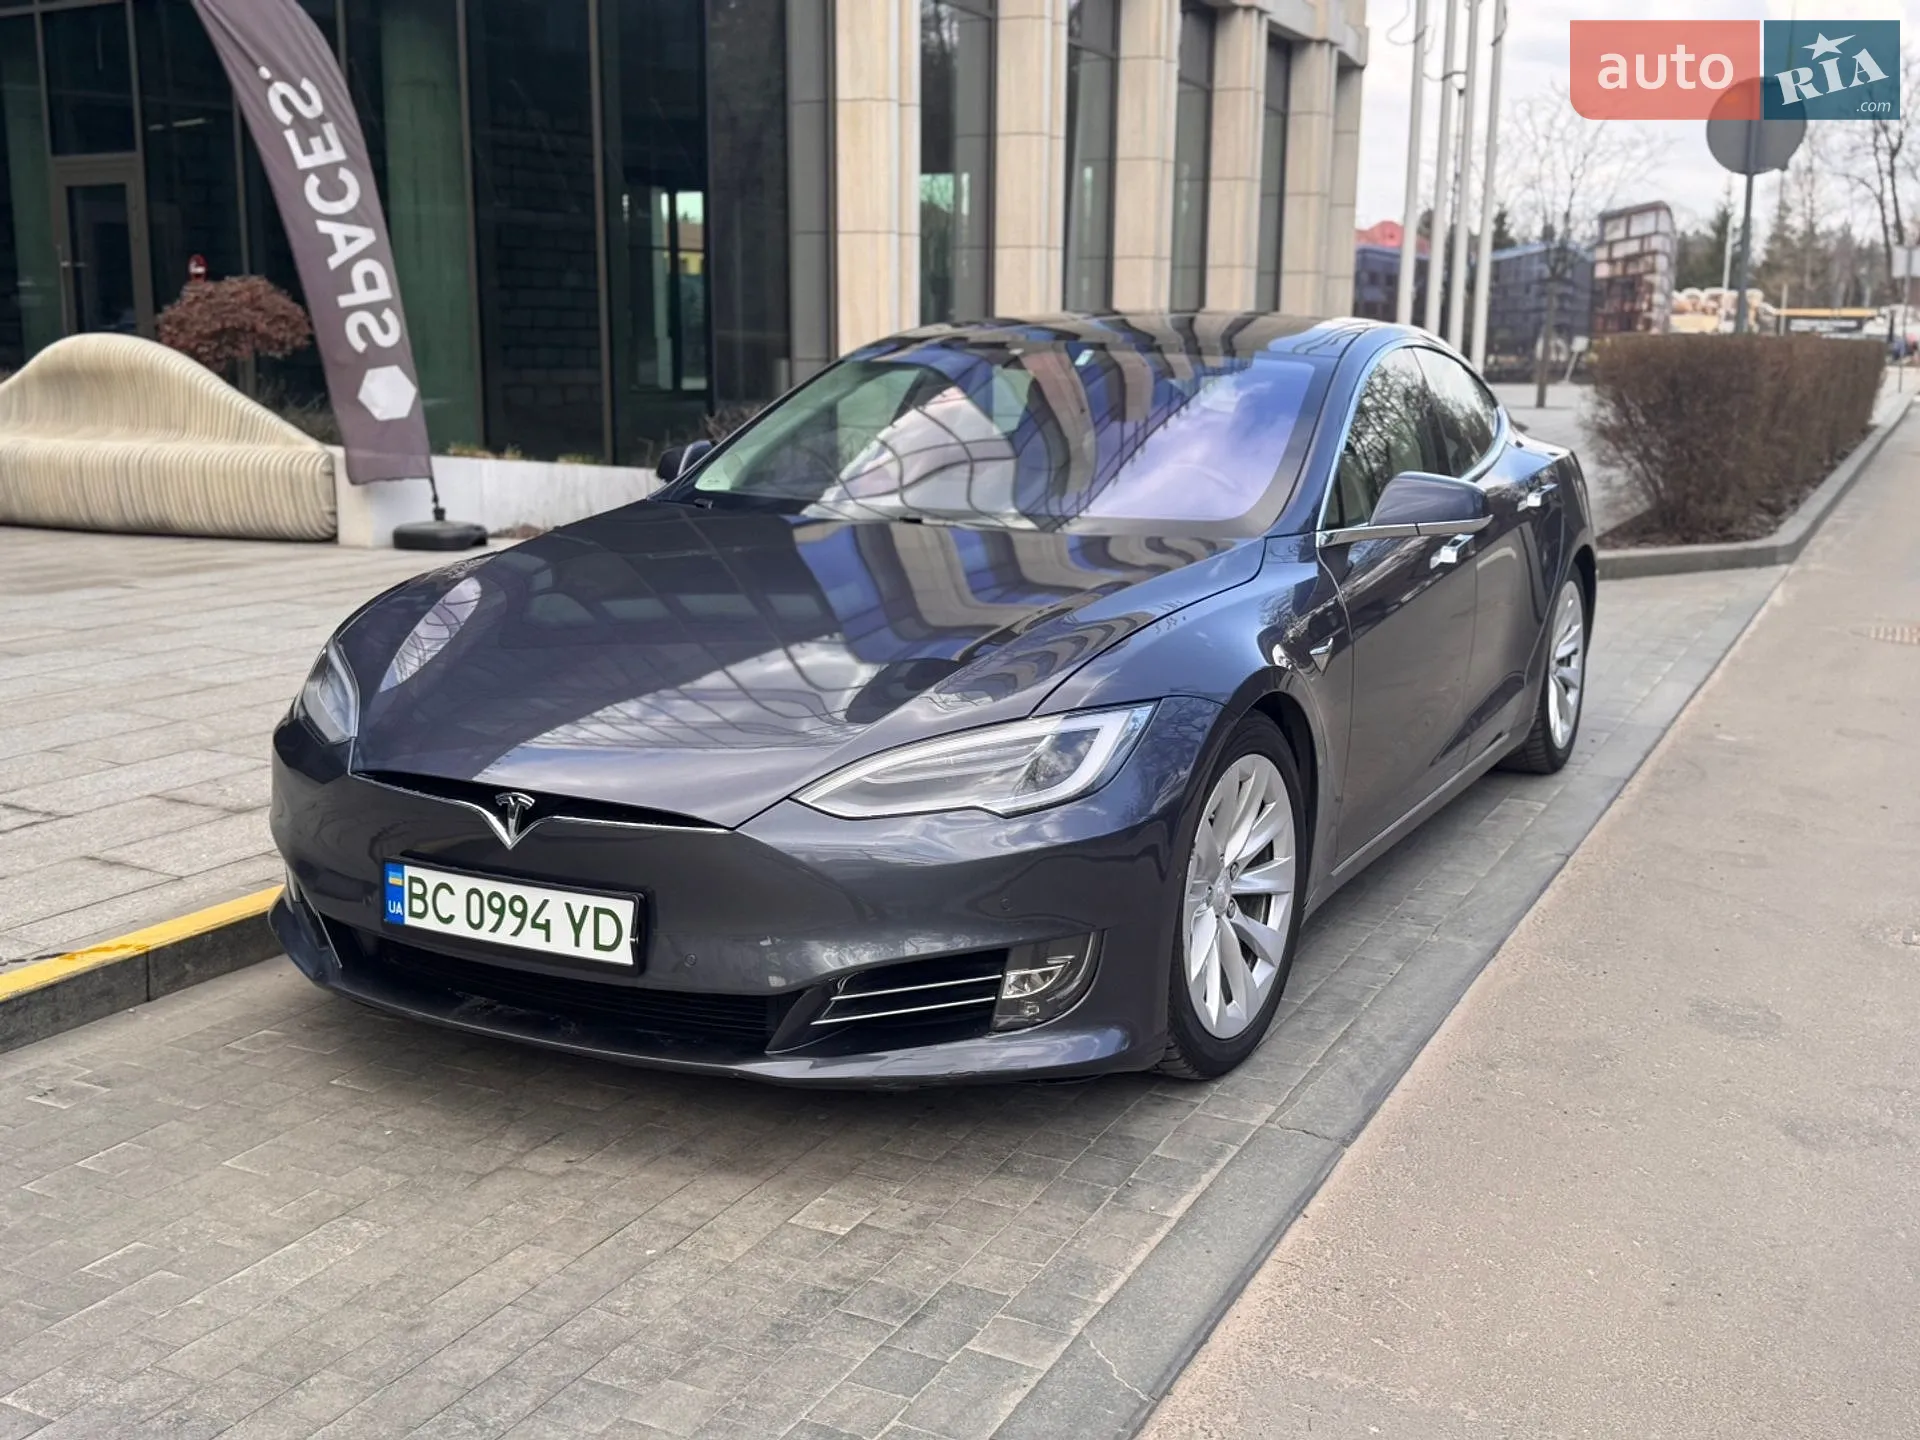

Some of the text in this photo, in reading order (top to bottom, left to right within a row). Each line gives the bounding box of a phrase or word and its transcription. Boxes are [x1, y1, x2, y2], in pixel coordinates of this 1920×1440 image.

[387, 900, 404, 916] UA
[407, 875, 624, 953] BC 0994 YD
